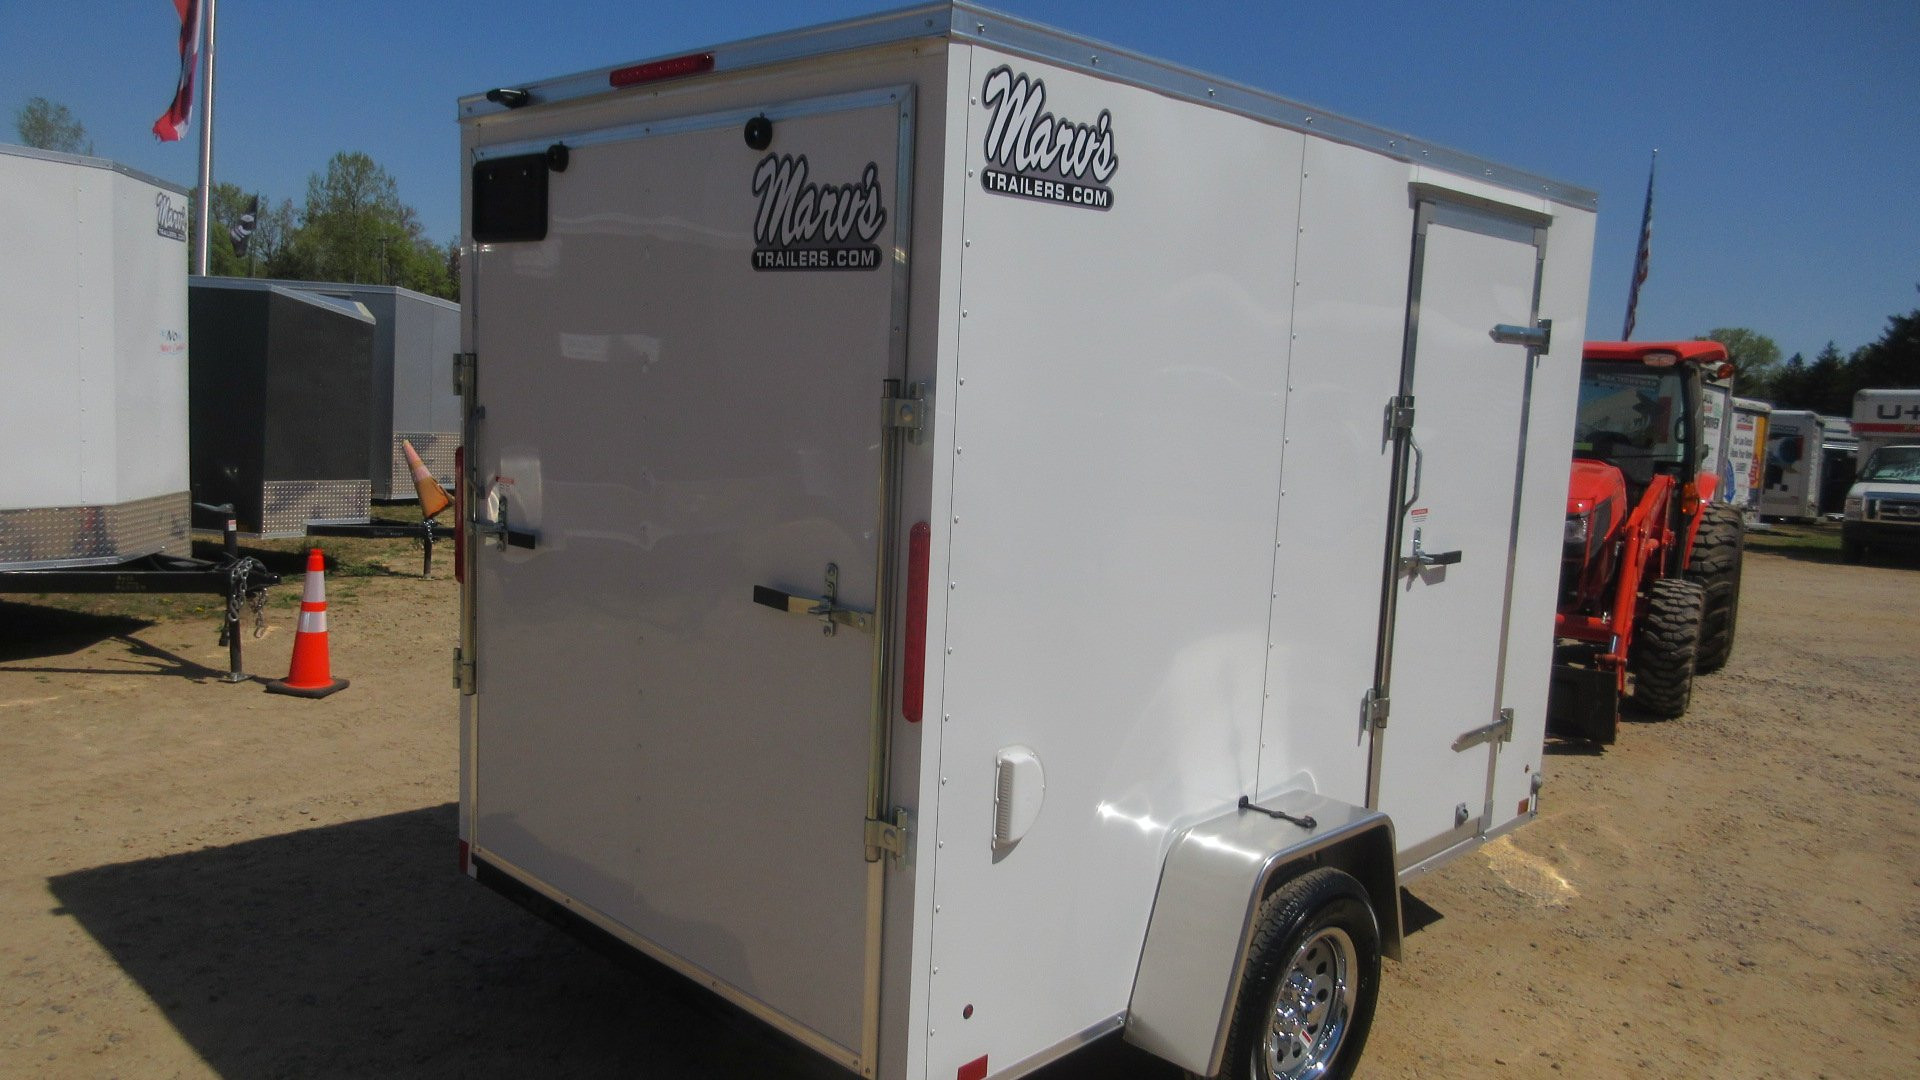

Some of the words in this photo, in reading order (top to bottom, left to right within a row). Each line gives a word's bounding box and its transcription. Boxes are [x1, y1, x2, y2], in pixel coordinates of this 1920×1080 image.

[983, 65, 1117, 183] Marv's
[753, 153, 886, 246] Marv's
[987, 171, 1108, 207] TRAILERS.COM
[756, 249, 875, 268] TRAILERS.COM
